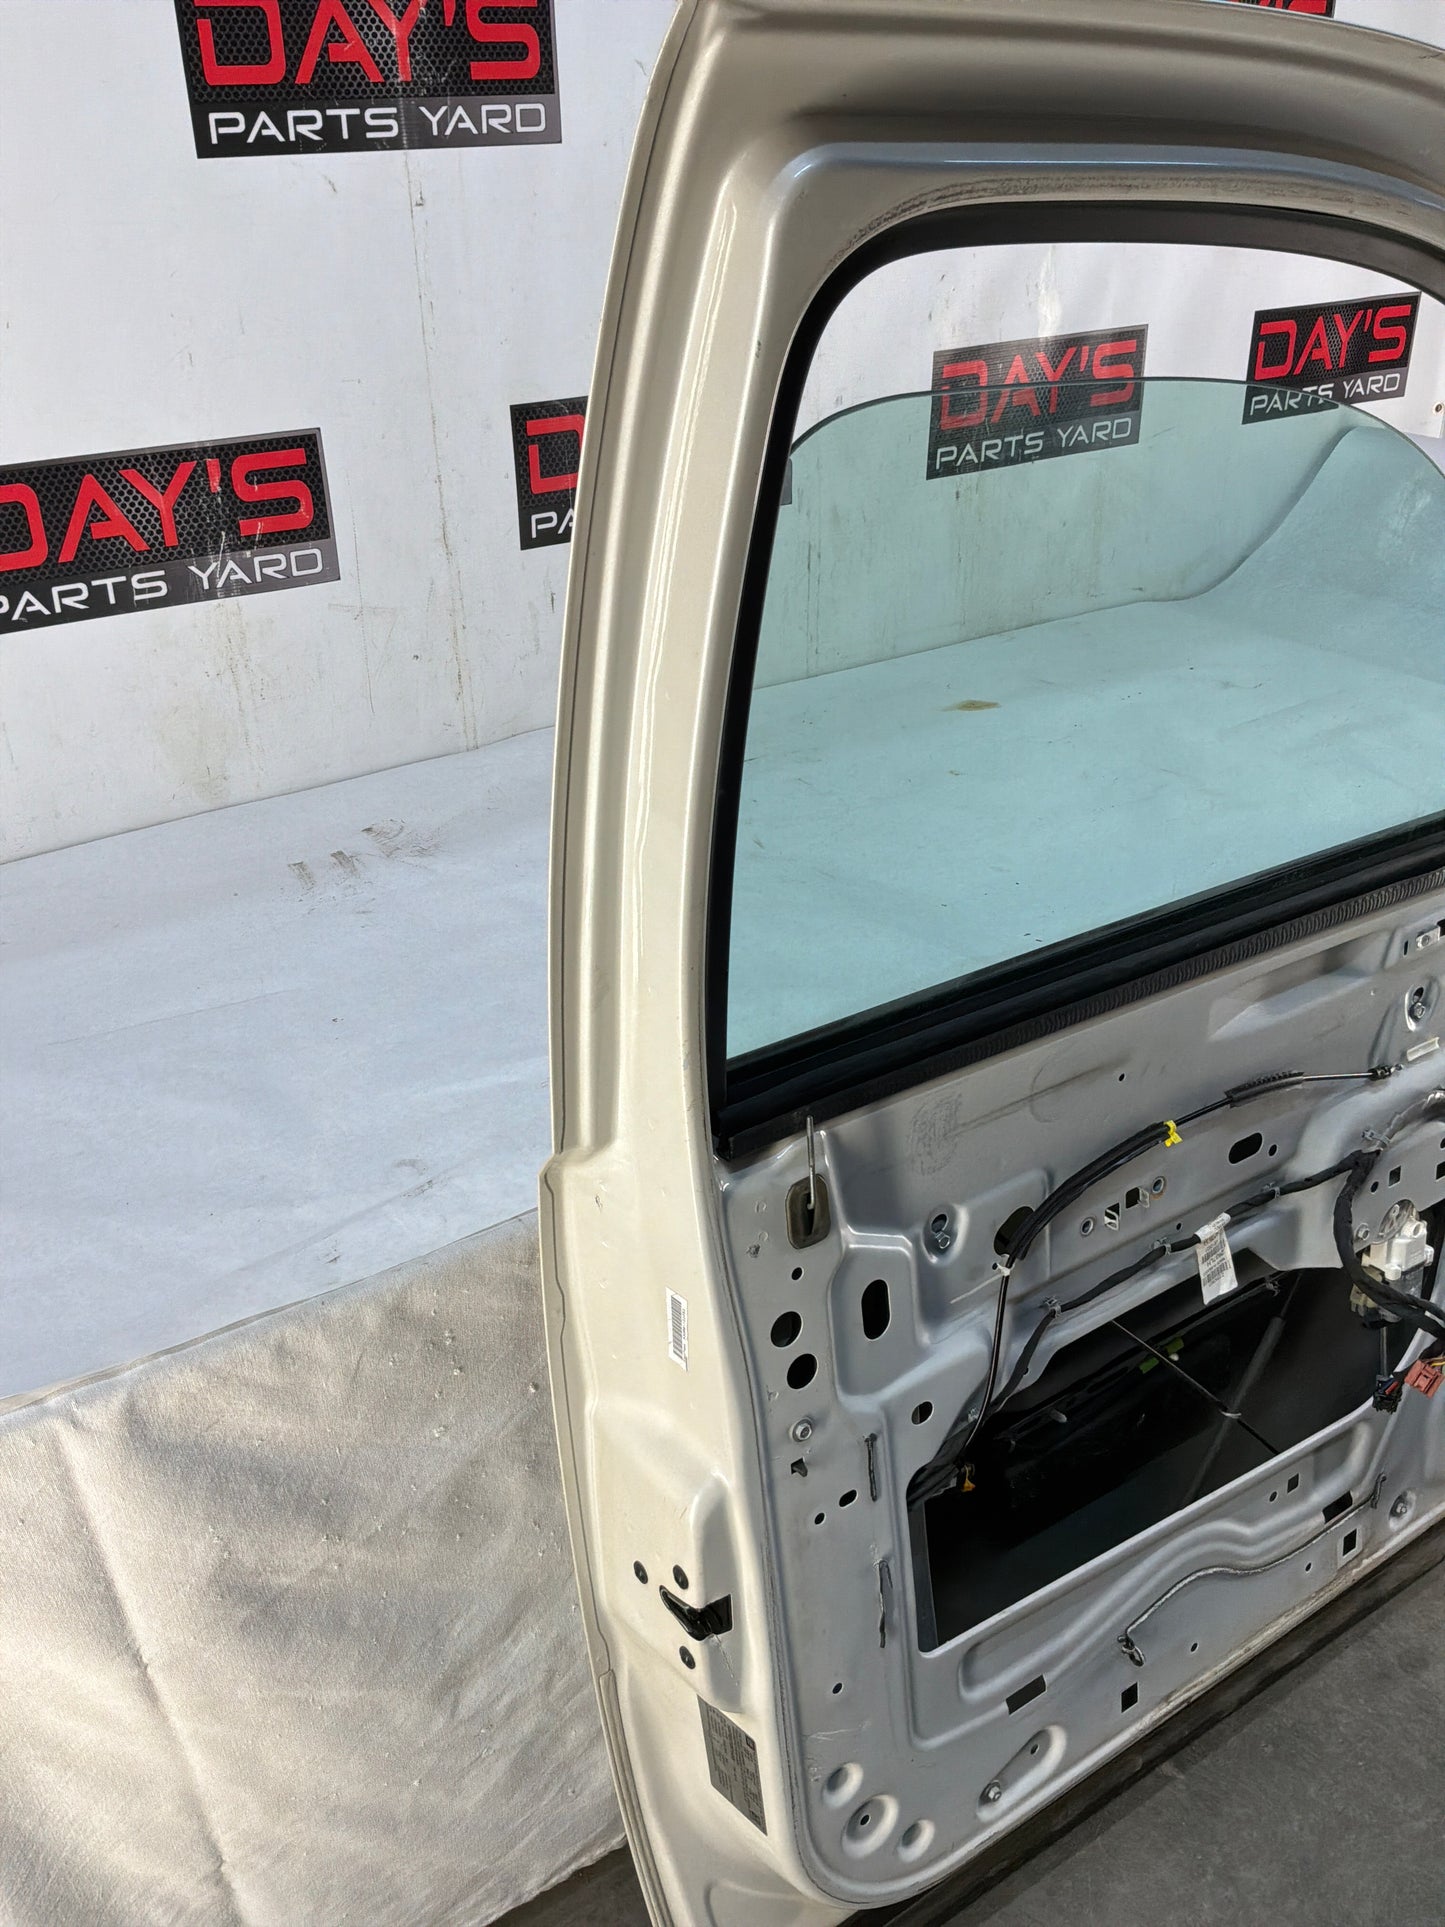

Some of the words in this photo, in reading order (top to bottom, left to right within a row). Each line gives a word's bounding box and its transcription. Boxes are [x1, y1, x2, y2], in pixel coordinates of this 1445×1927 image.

[194, 0, 541, 86] DAY'S
[208, 107, 399, 145] PARTS
[418, 103, 547, 136] YARD
[1254, 304, 1412, 381] DAY'S
[939, 339, 1137, 430] DAY'S
[1343, 373, 1401, 399] YARD
[935, 431, 1045, 470] PARTS
[1057, 417, 1132, 448] YARD
[0, 569, 168, 621] ARTS
[187, 548, 324, 590] YARD
